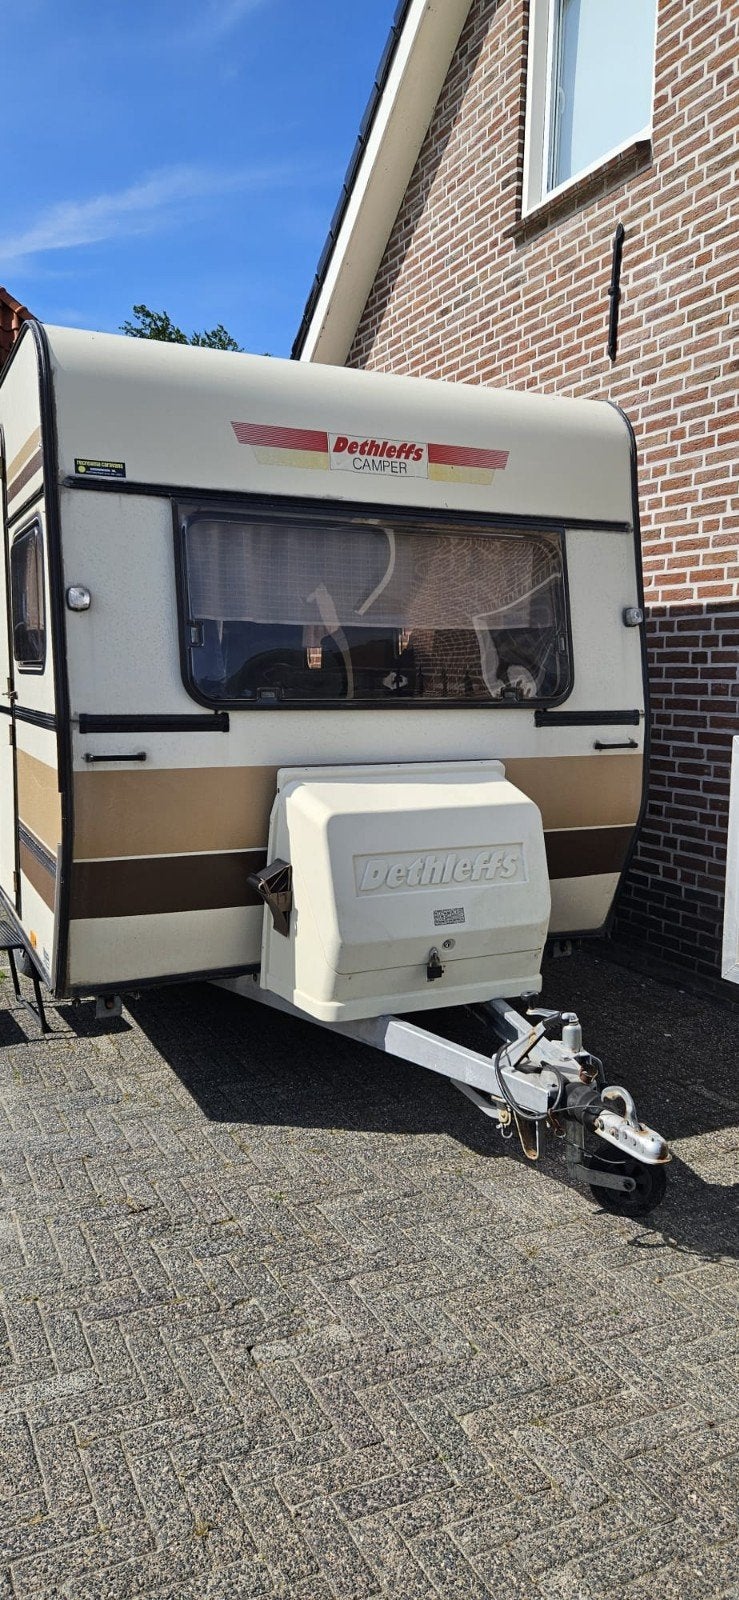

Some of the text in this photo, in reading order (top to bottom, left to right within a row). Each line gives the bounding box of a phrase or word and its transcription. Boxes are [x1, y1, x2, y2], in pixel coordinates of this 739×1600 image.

[333, 437, 423, 461] Dethleffs
[352, 457, 408, 473] CAMPER
[360, 851, 518, 891] Dethleffs
